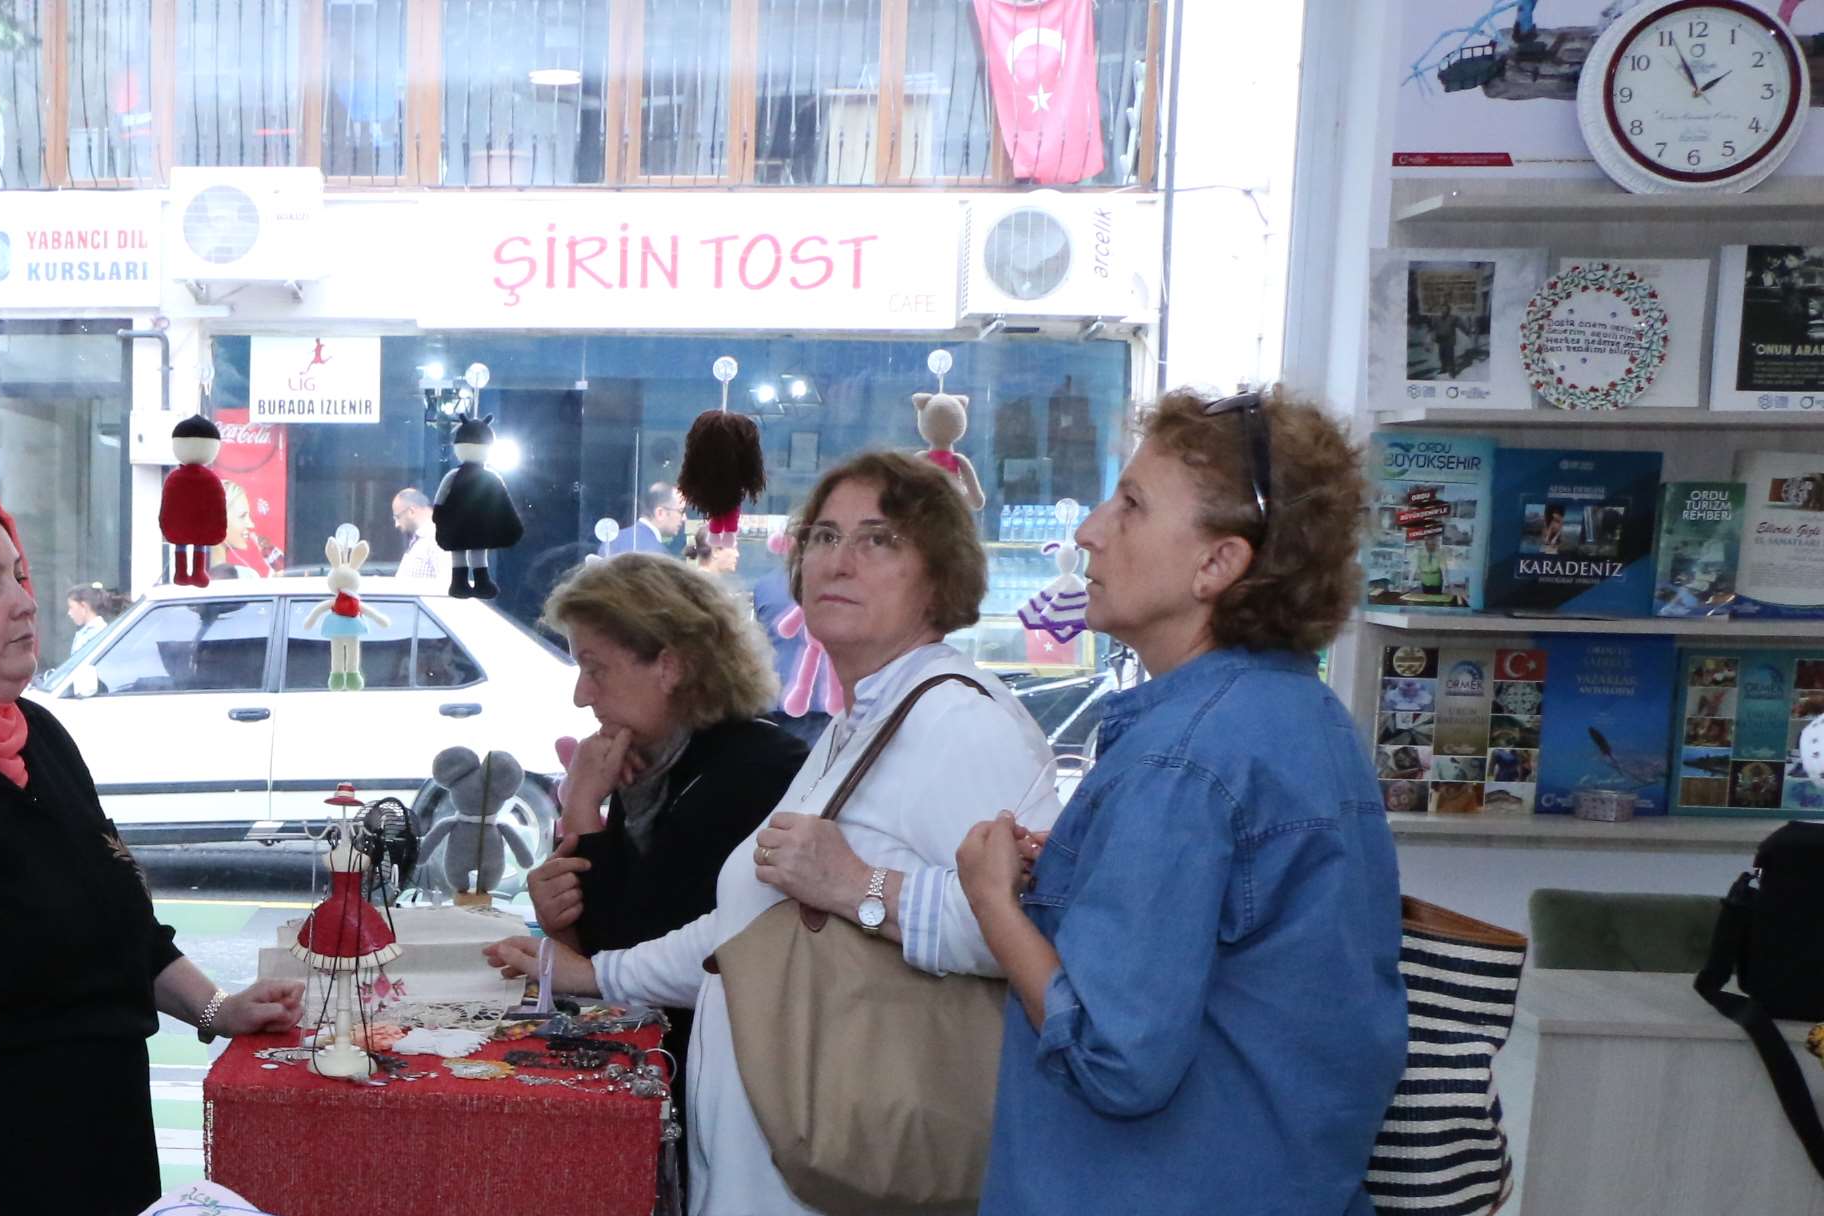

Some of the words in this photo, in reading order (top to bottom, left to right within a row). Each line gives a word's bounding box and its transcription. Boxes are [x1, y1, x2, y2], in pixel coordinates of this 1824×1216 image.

[1689, 21, 1708, 38] 12
[1730, 29, 1736, 45] 1
[1659, 31, 1673, 47] 11
[1631, 54, 1650, 71] 10
[1752, 51, 1764, 69] 2
[1620, 87, 1633, 104] 9
[1760, 83, 1774, 101] 3
[1630, 119, 1643, 136] 8
[1748, 117, 1762, 134] 4
[1655, 142, 1667, 158] 7
[1687, 149, 1701, 166] 6
[1722, 141, 1736, 157] 5
[26, 229, 108, 250] YABANCI
[26, 260, 149, 282] KURSLARI
[492, 222, 678, 307] ŞİRİN
[699, 234, 878, 290] TOST
[888, 294, 937, 313] CAFE
[257, 398, 315, 415] BURADA
[1690, 490, 1729, 501] ORDU
[1519, 559, 1624, 577] KARADENİZ
